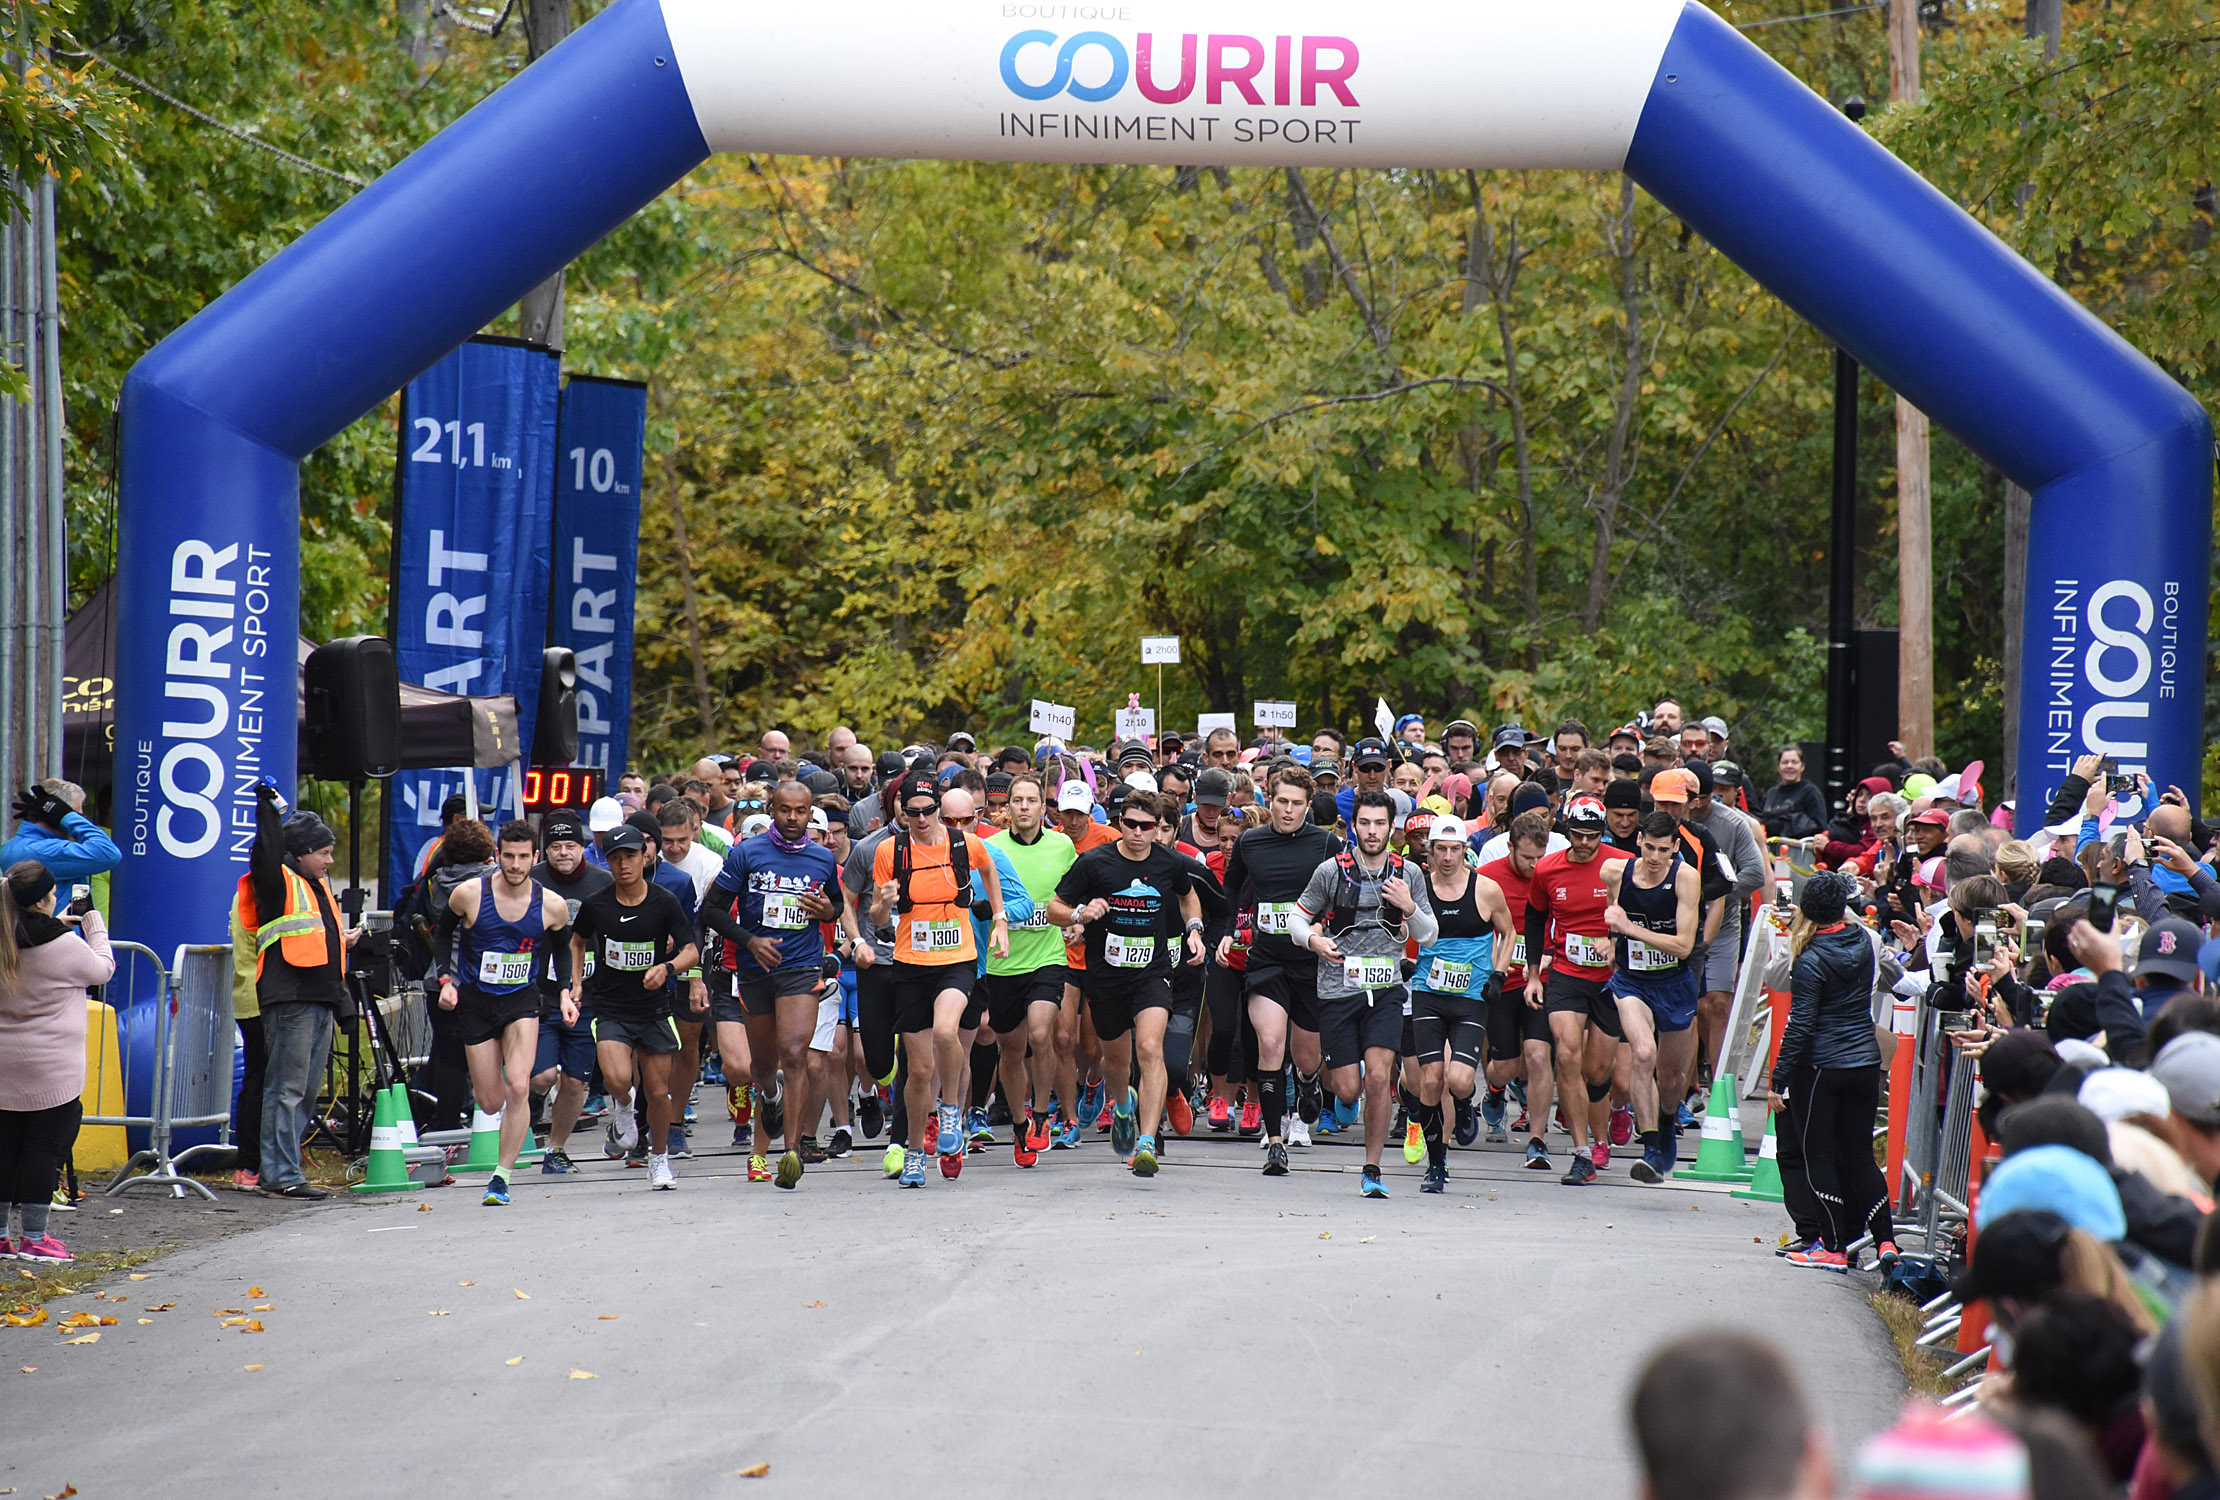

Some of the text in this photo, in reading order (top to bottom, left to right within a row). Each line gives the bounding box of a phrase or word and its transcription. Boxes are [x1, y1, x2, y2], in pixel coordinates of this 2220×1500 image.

[1001, 5, 1131, 20] BOUTIQUE
[999, 29, 1361, 107] COURIR
[1000, 112, 1361, 144] INFINIMENT SPORT
[411, 417, 512, 469] 21,1 km
[570, 447, 630, 494] 10 km
[2160, 581, 2179, 699] BOUTIQUE
[1155, 645, 1178, 655] 2h00
[2046, 580, 2079, 776] INFINIMENT
[156, 539, 239, 859] COURIR
[230, 543, 271, 862] INFINIMENT SPORT
[1047, 713, 1072, 726] 1h40
[1270, 710, 1294, 720] 1h50
[133, 740, 153, 856] BOUTIQUE
[1107, 896, 1146, 908] CANADA
[1274, 913, 1290, 929] 13
[931, 929, 959, 946] 1300
[624, 951, 652, 967] 1509
[1125, 947, 1151, 963] 1279
[502, 962, 529, 979] 1508
[1364, 967, 1392, 983] 1526
[1443, 971, 1471, 989] 1486
